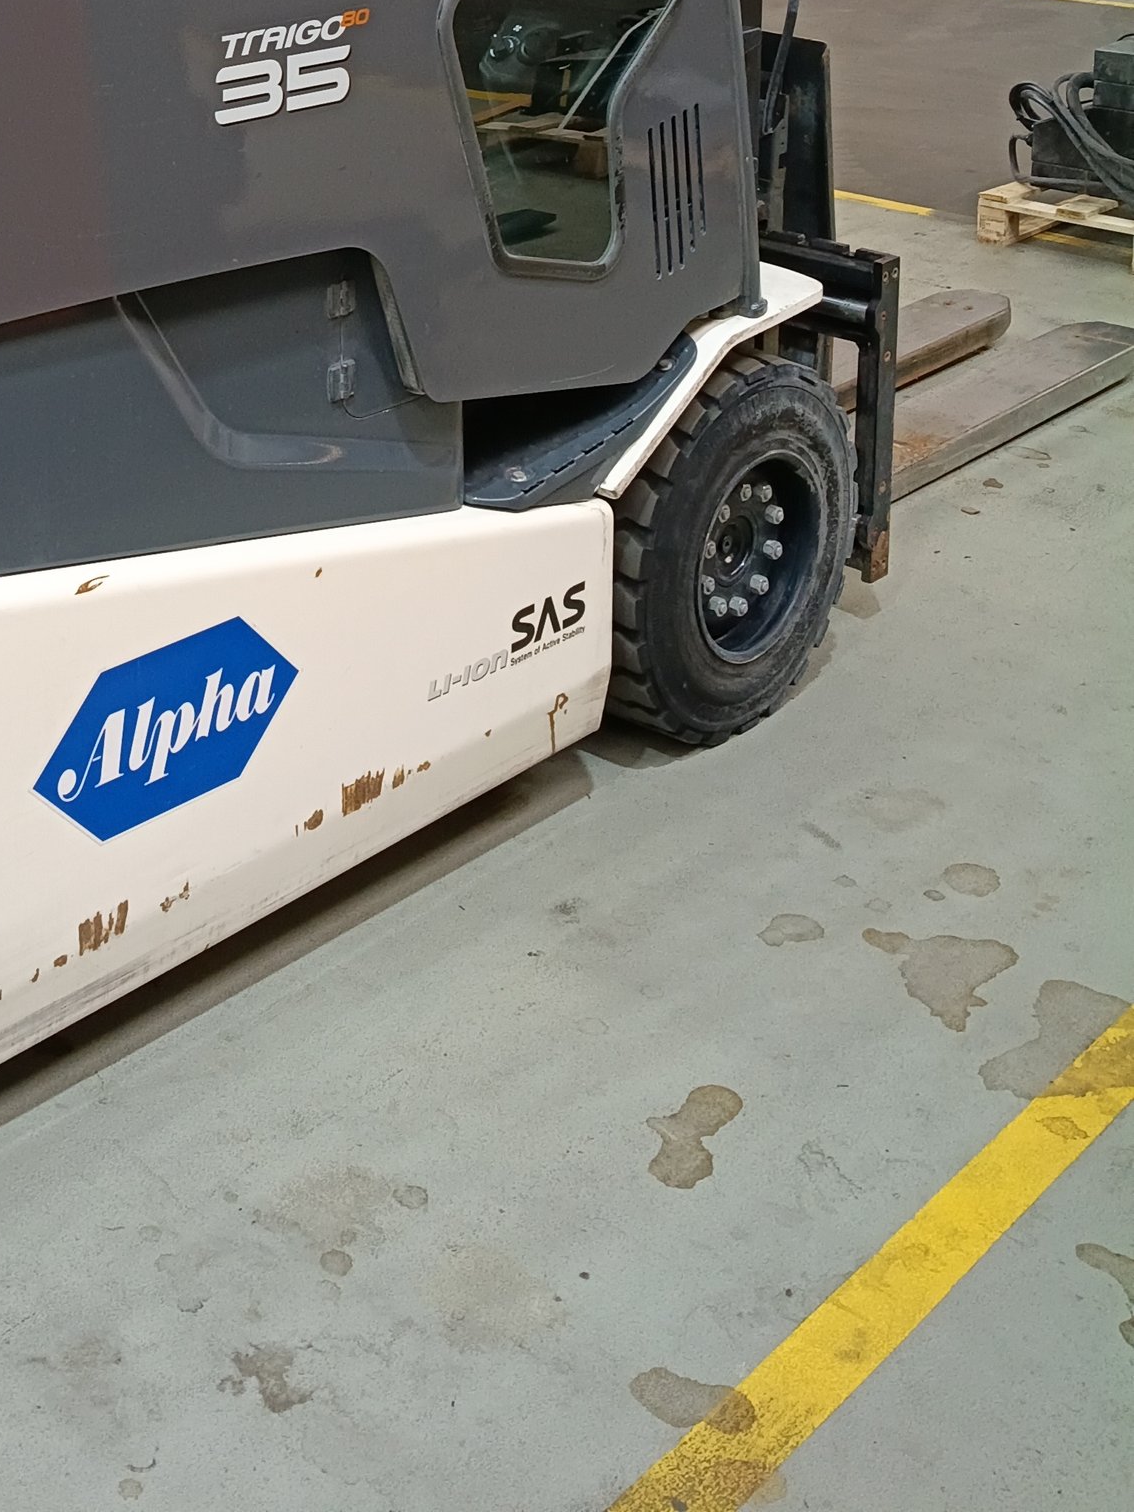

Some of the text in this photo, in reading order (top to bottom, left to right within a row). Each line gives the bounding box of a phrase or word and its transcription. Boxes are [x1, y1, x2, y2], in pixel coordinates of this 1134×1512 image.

[214, 44, 351, 126] 35
[510, 580, 586, 653] SAS
[510, 625, 586, 667] System of Active Stability
[56, 663, 276, 803] Alpha
